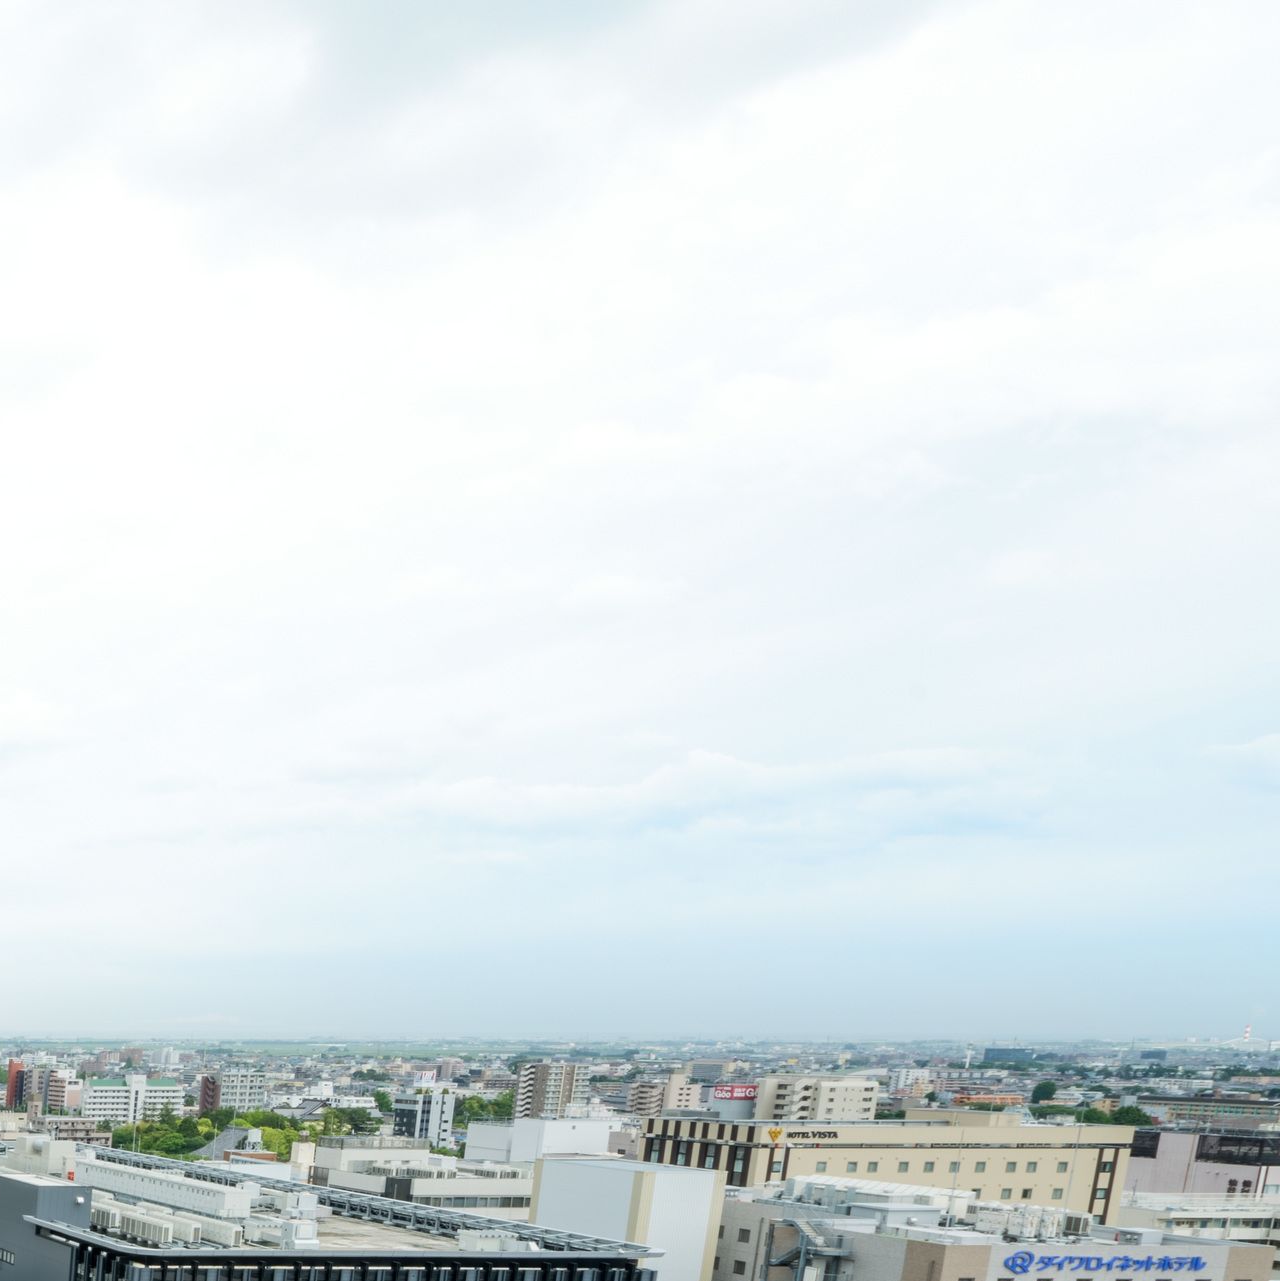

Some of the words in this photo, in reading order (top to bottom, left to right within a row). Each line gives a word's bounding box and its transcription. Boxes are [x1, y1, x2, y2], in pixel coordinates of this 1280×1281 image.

[812, 1131, 838, 1139] VISTA
[1035, 1255, 1207, 1272] ダイワロイネットホテル
